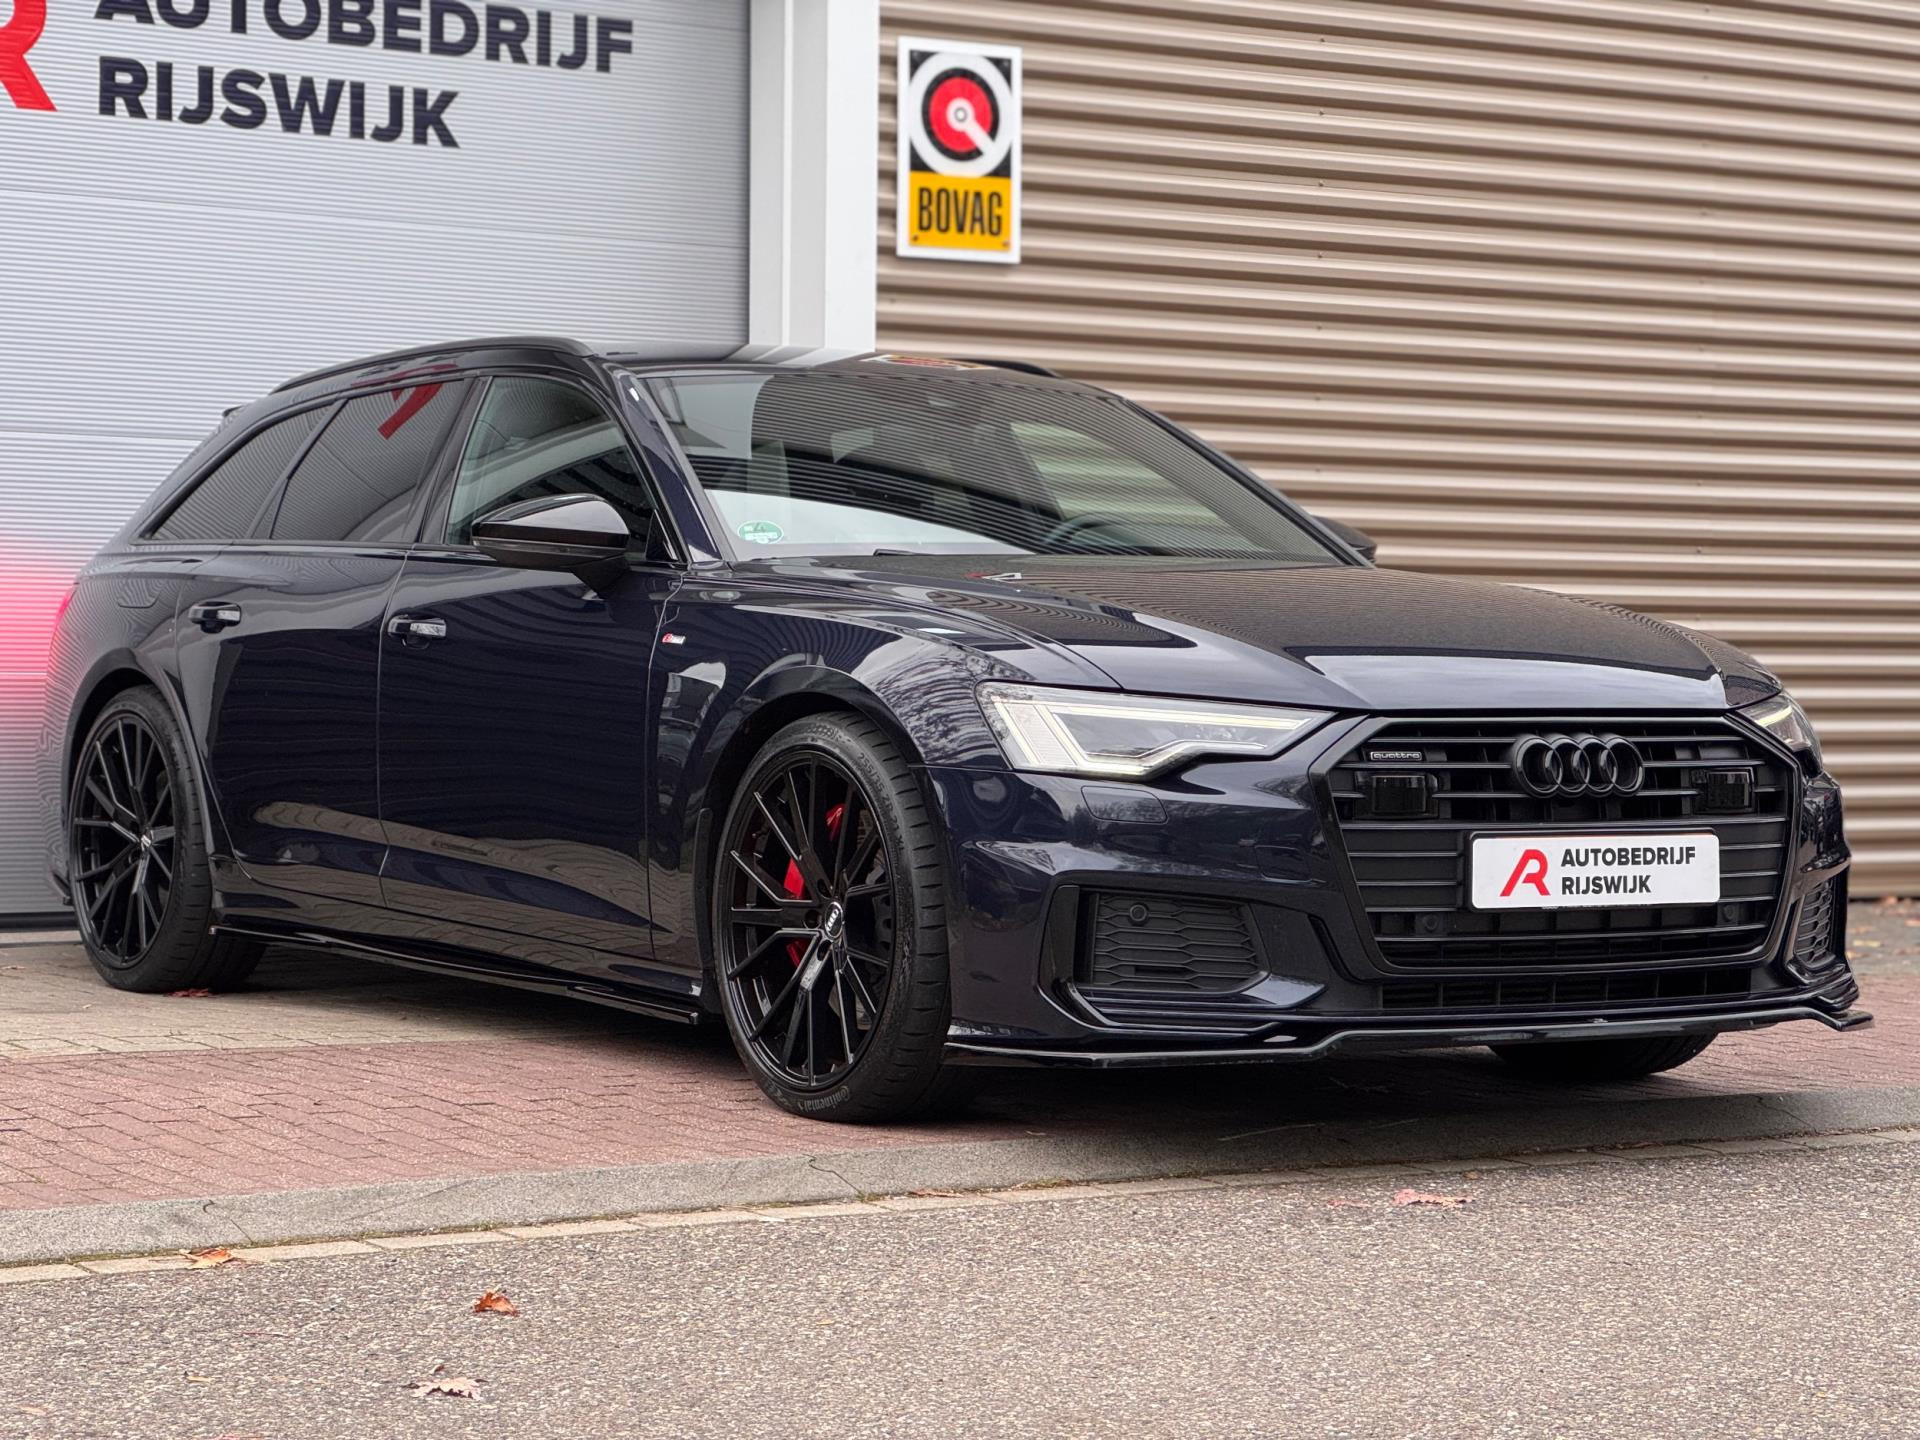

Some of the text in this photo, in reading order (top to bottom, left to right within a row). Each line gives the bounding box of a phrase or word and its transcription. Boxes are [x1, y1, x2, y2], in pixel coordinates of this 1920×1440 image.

[99, 56, 459, 148] RIJSWIJK
[917, 187, 1002, 236] BOVAG
[1373, 752, 1420, 760] quattro
[1561, 846, 1696, 867] AUTOBEDRIJF
[1561, 875, 1652, 895] RIJSWIJK
[803, 1084, 851, 1112] Continental
